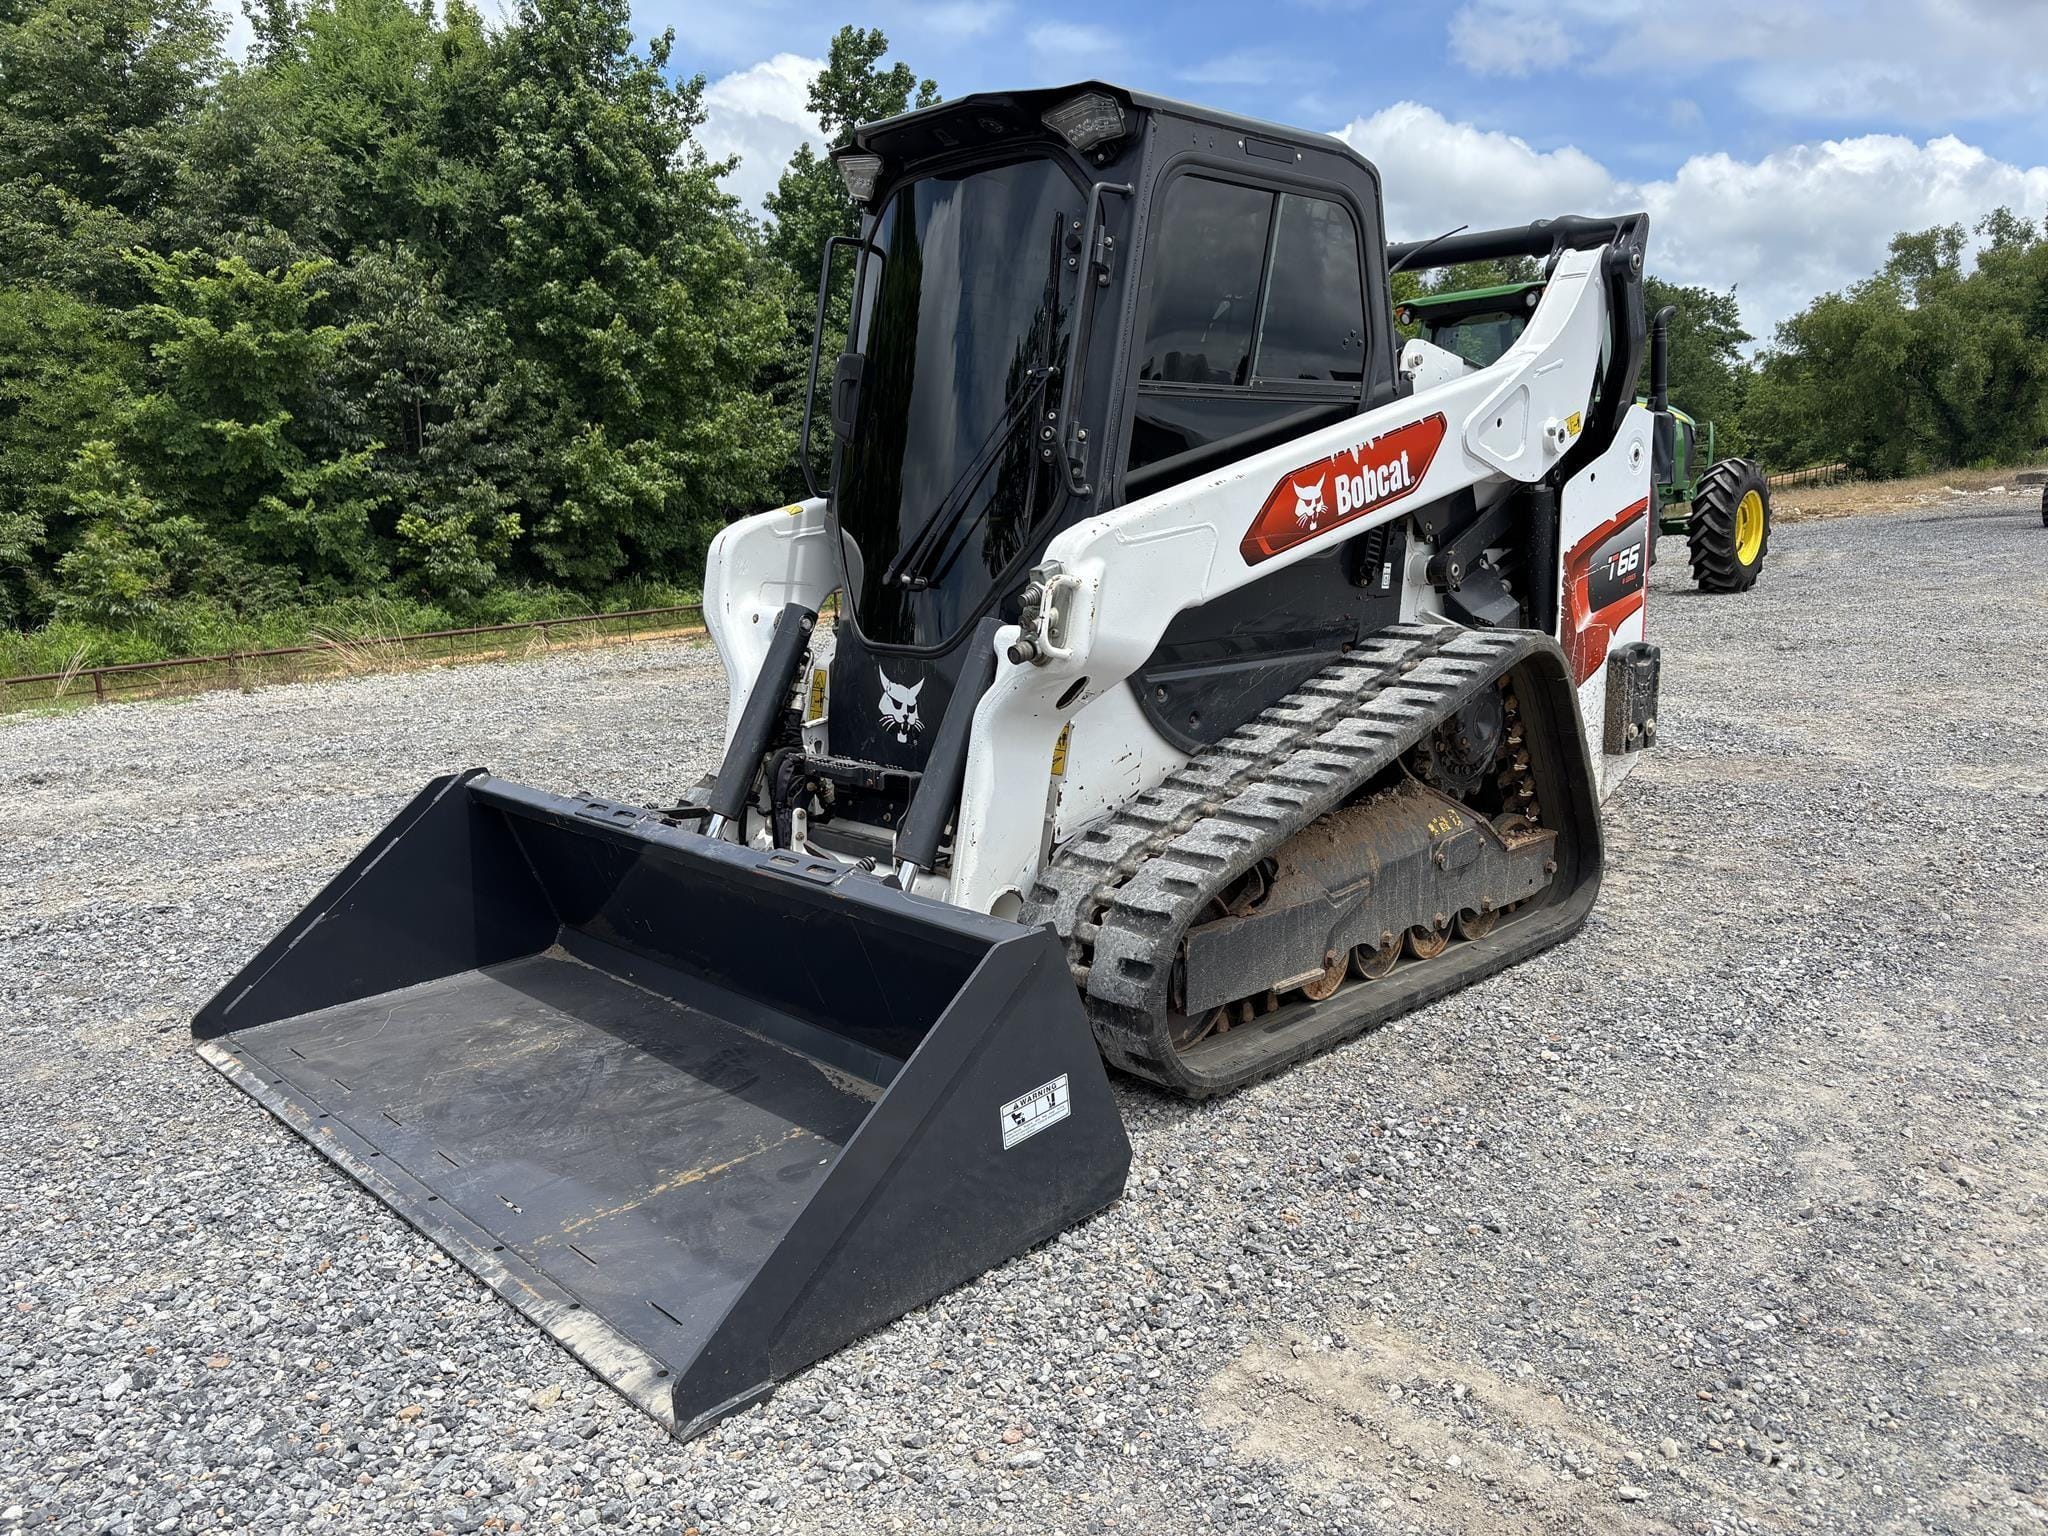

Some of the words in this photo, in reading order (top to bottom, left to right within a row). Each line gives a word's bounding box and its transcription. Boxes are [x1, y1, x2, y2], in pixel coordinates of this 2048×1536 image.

[1334, 449, 1411, 516] Bobcat
[1608, 543, 1641, 581] T66
[1020, 1083, 1057, 1106] WARNING
